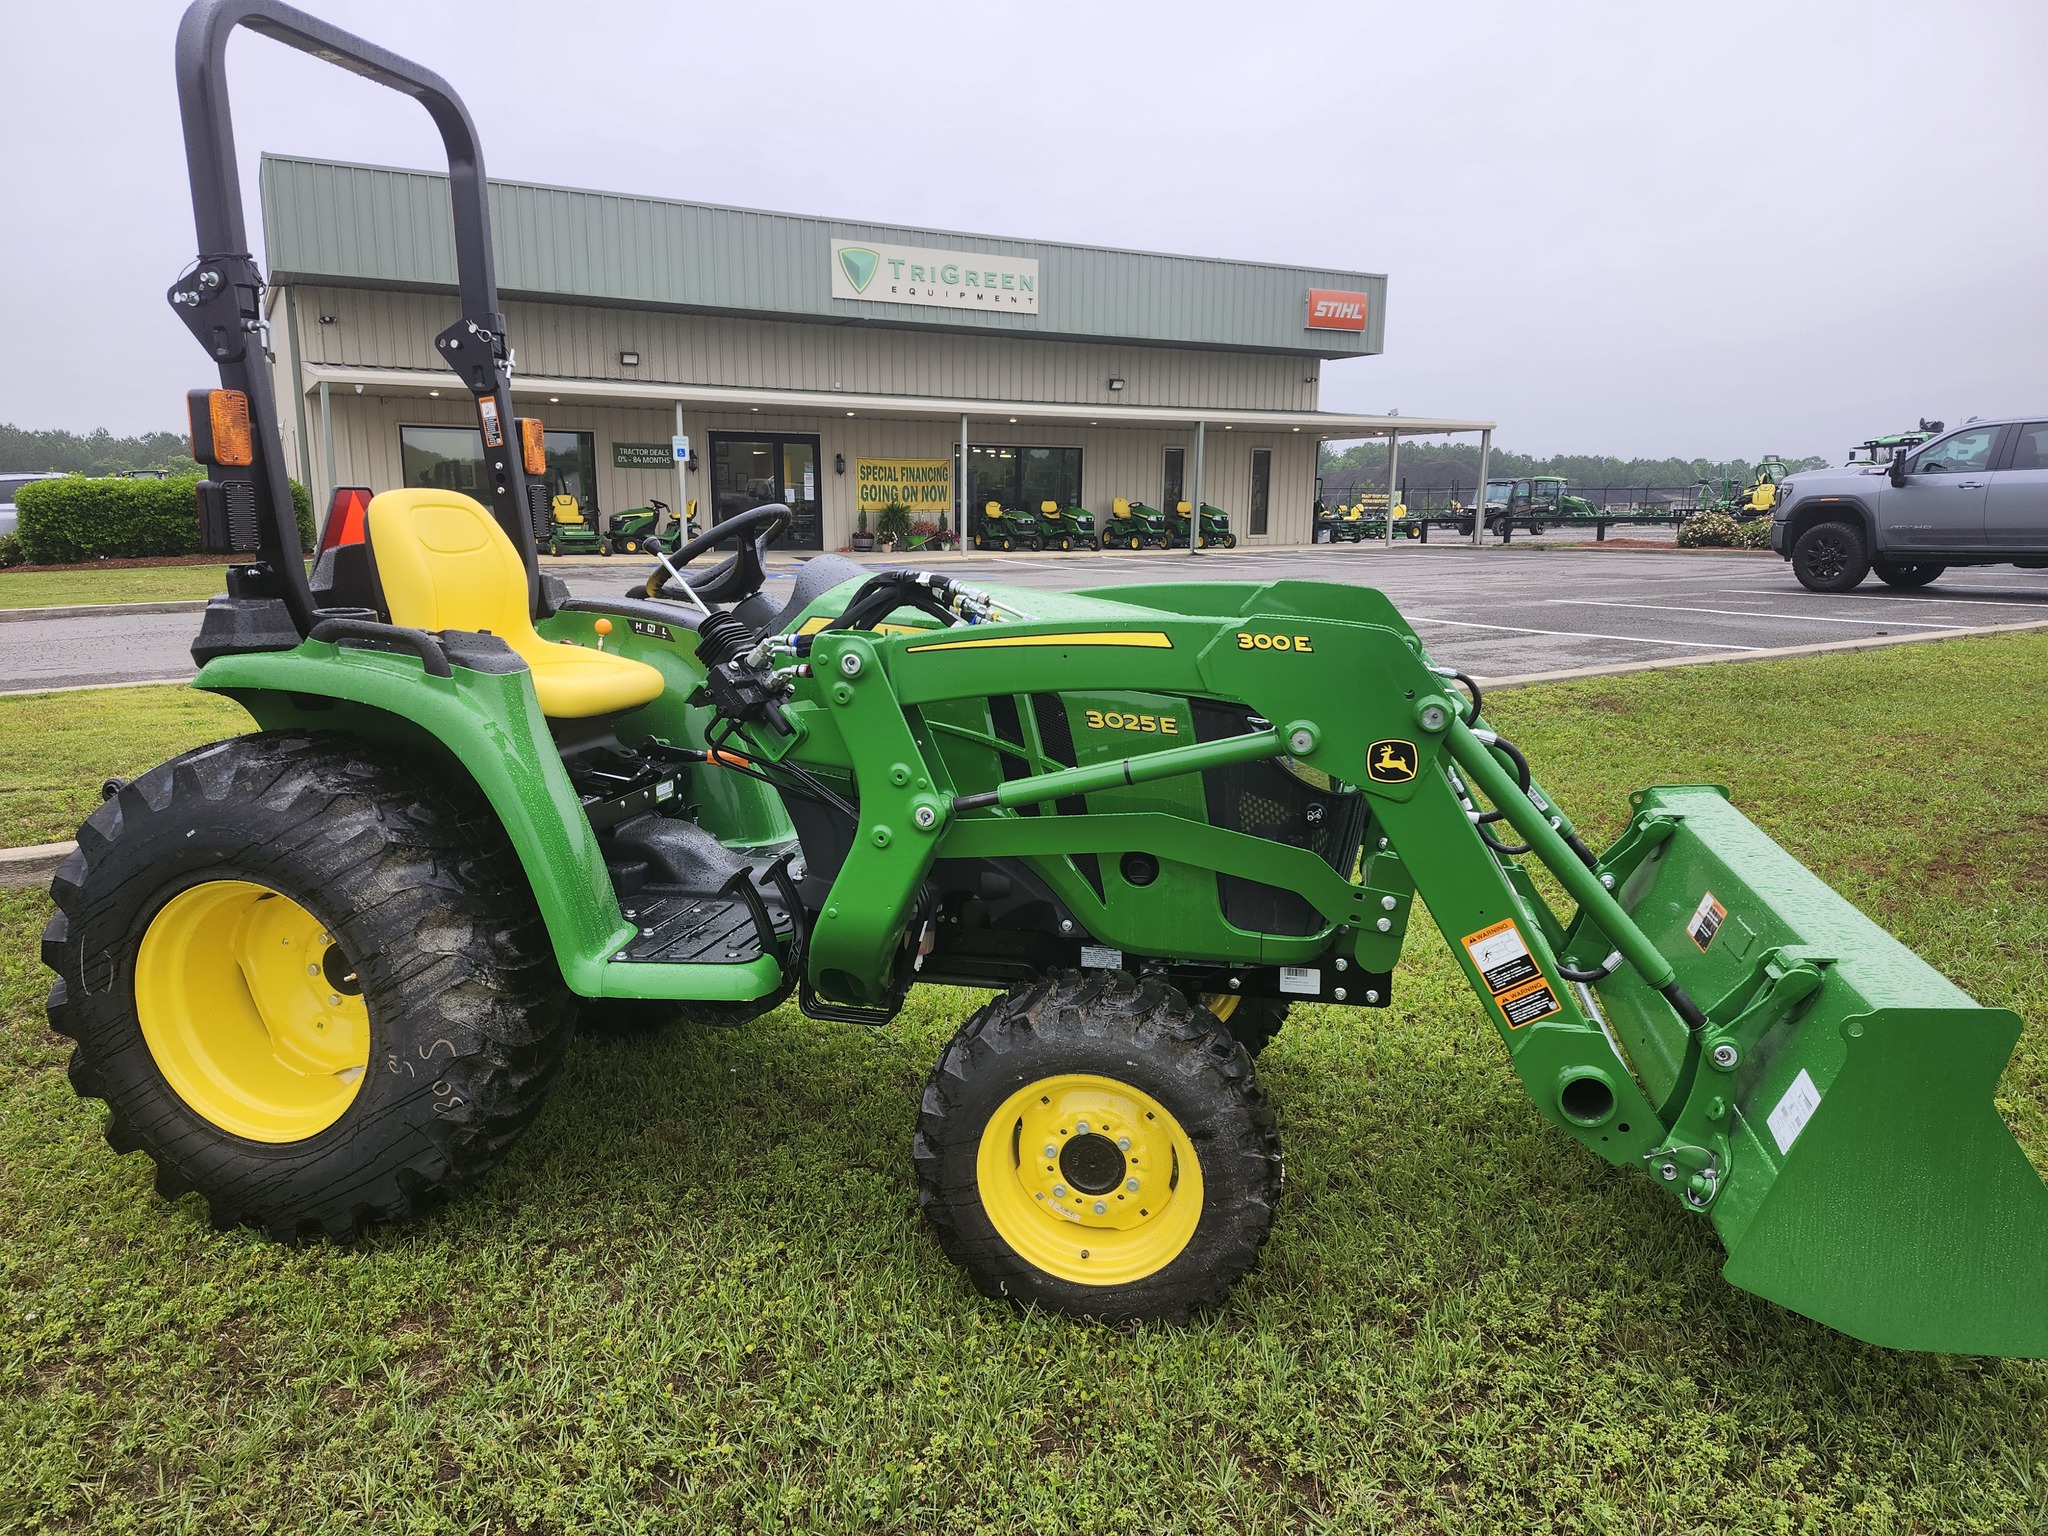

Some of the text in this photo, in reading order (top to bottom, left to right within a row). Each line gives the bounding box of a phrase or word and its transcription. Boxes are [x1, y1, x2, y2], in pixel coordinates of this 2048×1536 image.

[891, 286, 1034, 305] EQUIPMENT
[1314, 301, 1363, 320] STIHL
[619, 448, 649, 456] TRACTOR
[860, 465, 948, 482] SPECIAL FINANCING
[860, 484, 948, 502] GOING ON NOW
[635, 622, 642, 630] H
[662, 627, 667, 635] L
[1476, 923, 1509, 940] WARNING
[1510, 982, 1543, 999] WARNING
